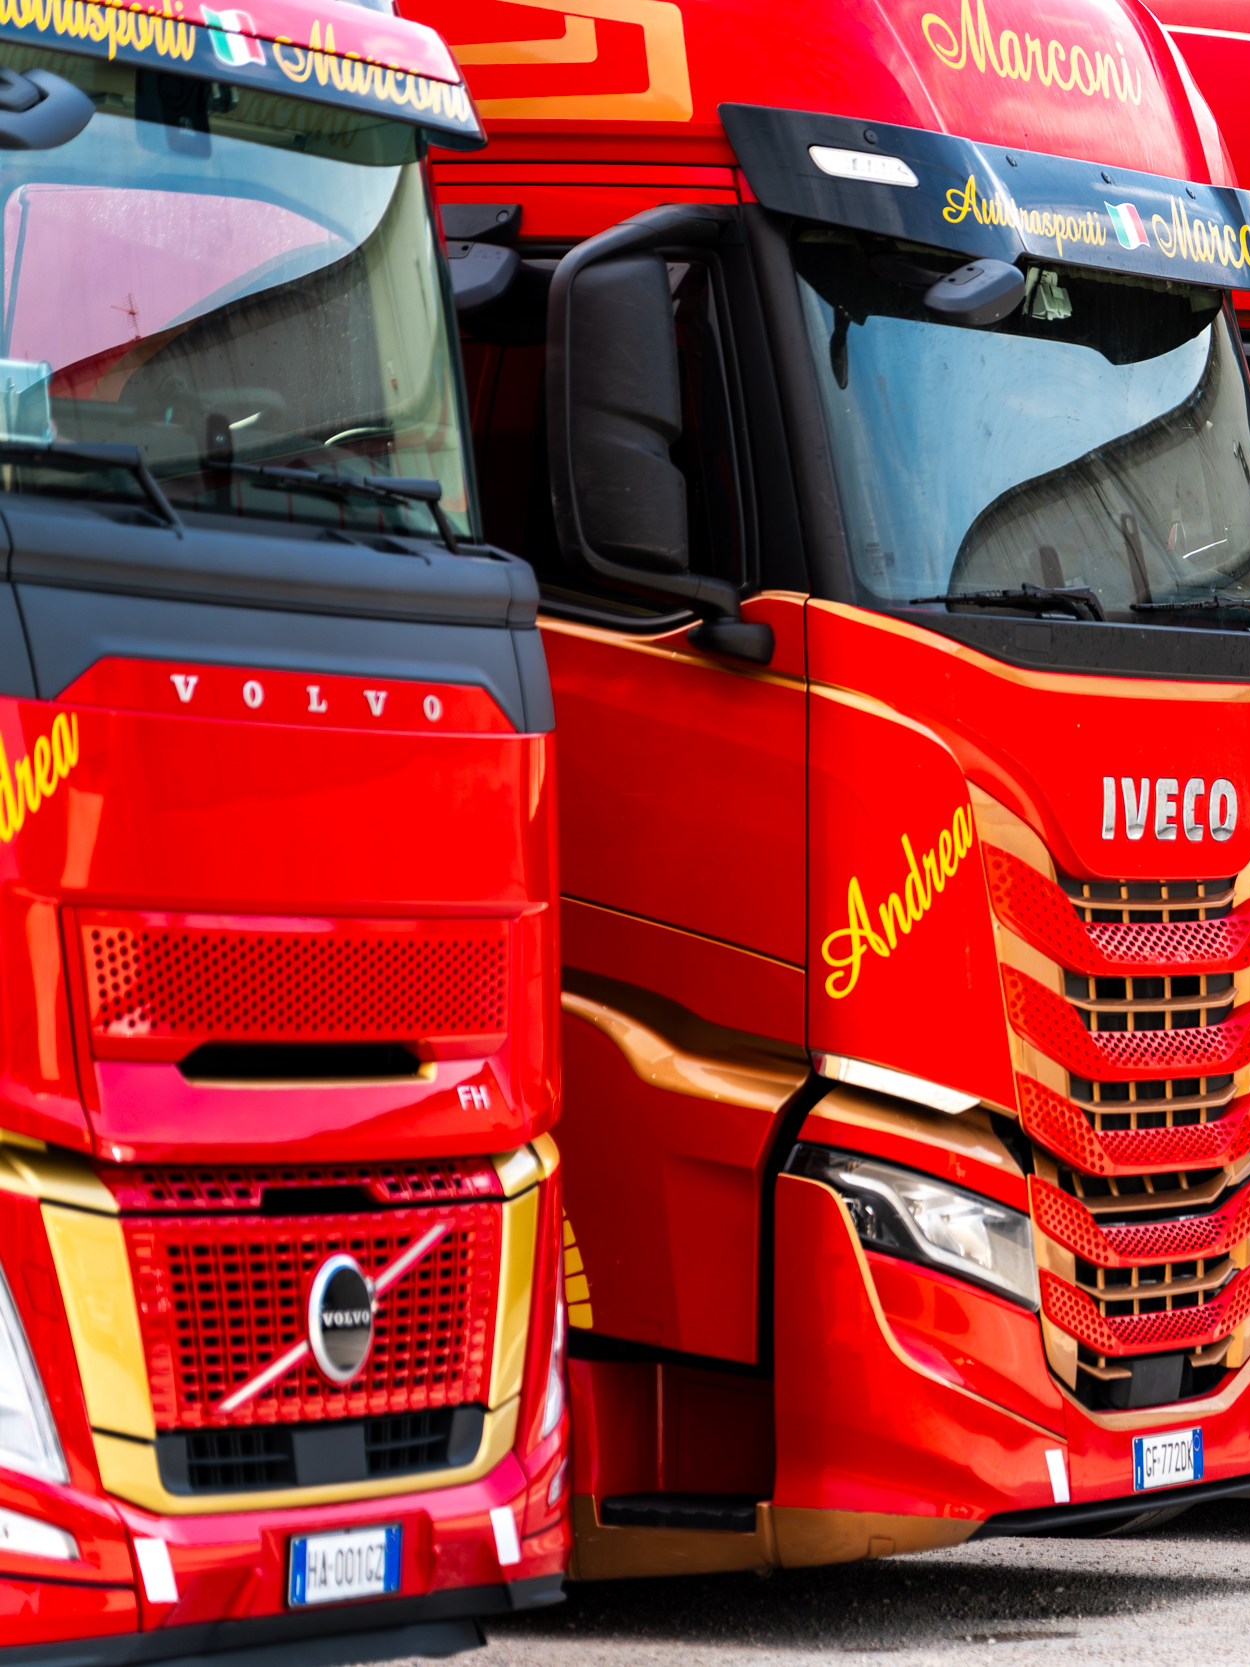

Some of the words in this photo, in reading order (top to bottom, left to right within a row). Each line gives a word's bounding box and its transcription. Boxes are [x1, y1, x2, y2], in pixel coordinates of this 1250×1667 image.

[272, 19, 469, 121] Marconi
[921, 0, 1141, 105] Marconi
[942, 174, 1107, 257] Autotrasporti
[1102, 776, 1239, 841] IVECO
[821, 802, 973, 999] Andrea
[456, 1085, 489, 1111] FH
[321, 1309, 371, 1328] VOLVO
